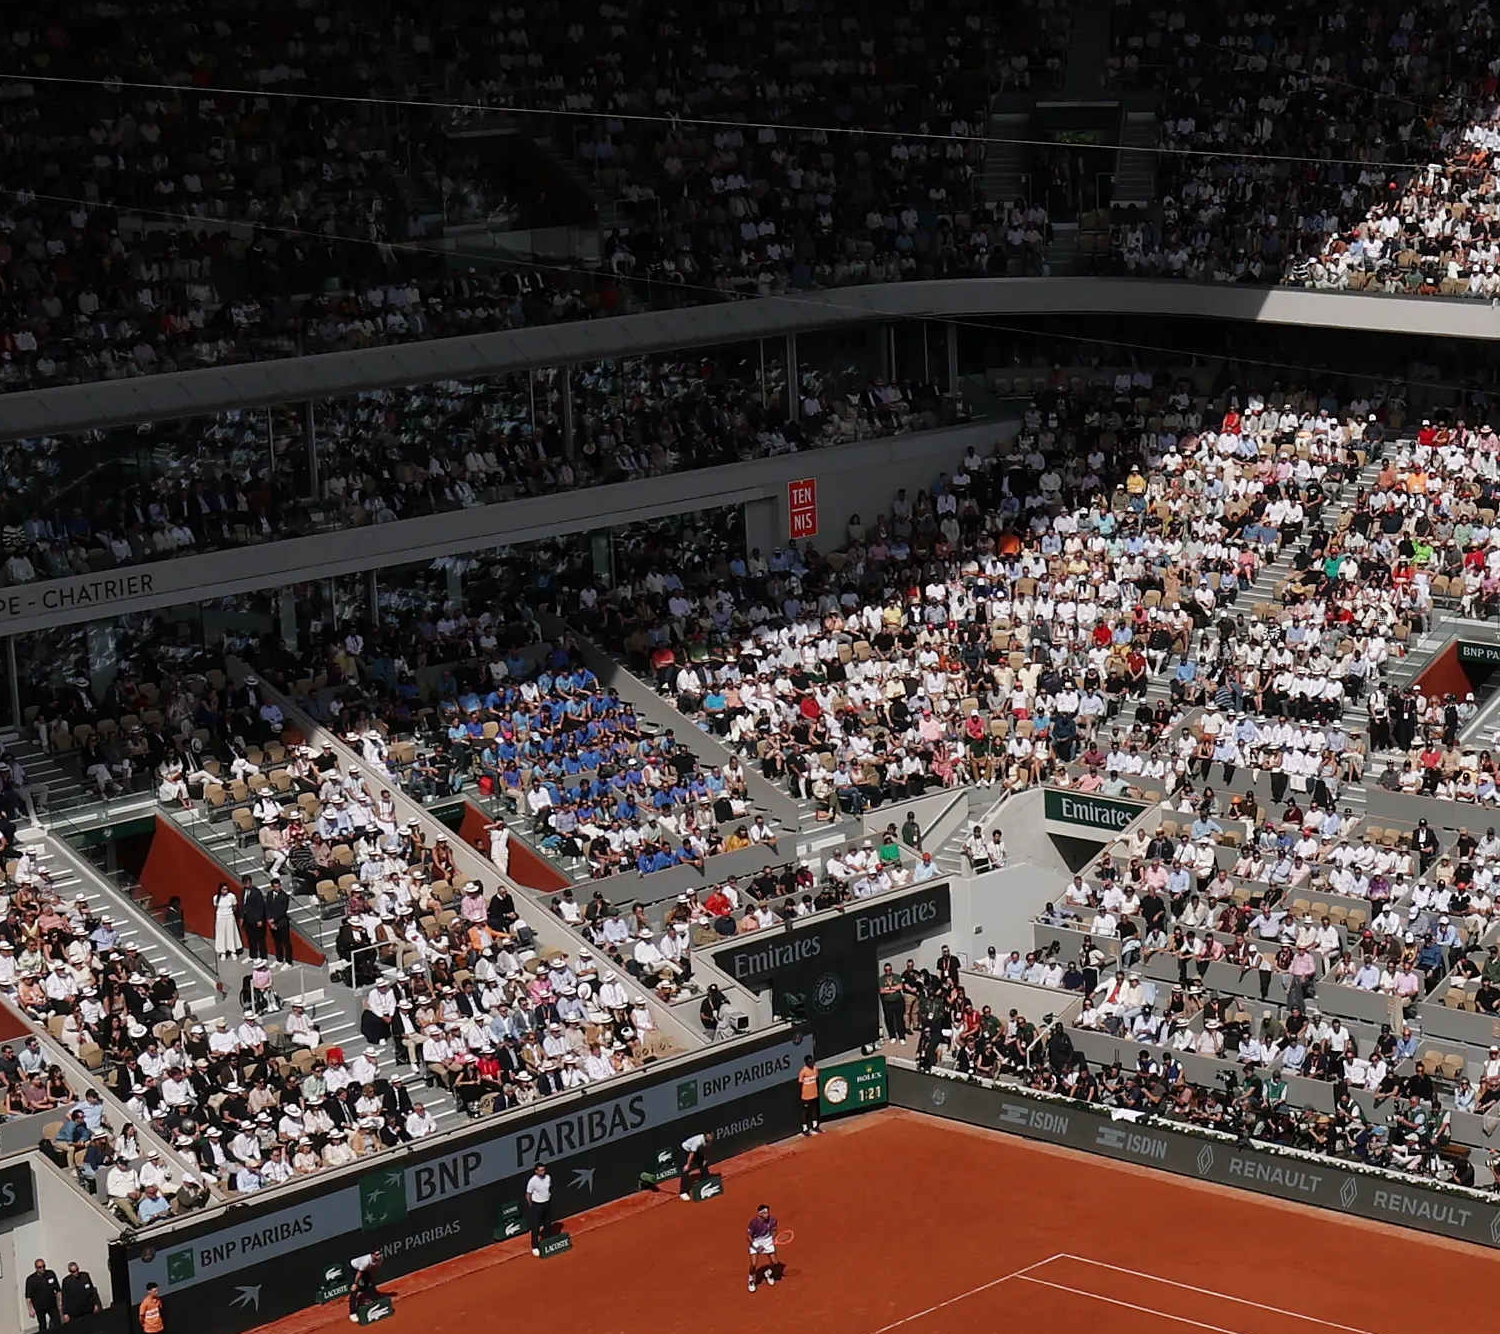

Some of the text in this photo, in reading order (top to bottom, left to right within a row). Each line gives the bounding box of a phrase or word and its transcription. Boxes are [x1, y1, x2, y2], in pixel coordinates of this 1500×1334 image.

[792, 487, 812, 505] TEN
[794, 513, 813, 531] NIS
[42, 574, 154, 608] CHATRIER
[1463, 646, 1485, 659] BNP
[1062, 797, 1134, 829] Emirates
[855, 898, 937, 942] Emirates
[734, 935, 821, 980] Emirates
[702, 1054, 791, 1098] BNP PARIBAS
[856, 1071, 882, 1083] ROLEX
[859, 1085, 881, 1102] 1:21
[716, 1113, 765, 1140] PARIBAS
[1029, 1110, 1070, 1136] ISDIN
[414, 1094, 647, 1203] BNP PARIBAS
[1126, 1132, 1168, 1160] ISDIN
[655, 1167, 678, 1180] LACOSTE
[1229, 1157, 1323, 1193] RENAULT
[1373, 1190, 1472, 1227] RENAULT
[199, 1213, 314, 1270] BNP PARIBAS
[409, 1219, 461, 1250] PARIBAS
[543, 1237, 571, 1253] LACOSTE
[322, 1284, 348, 1301] LACOSTE
